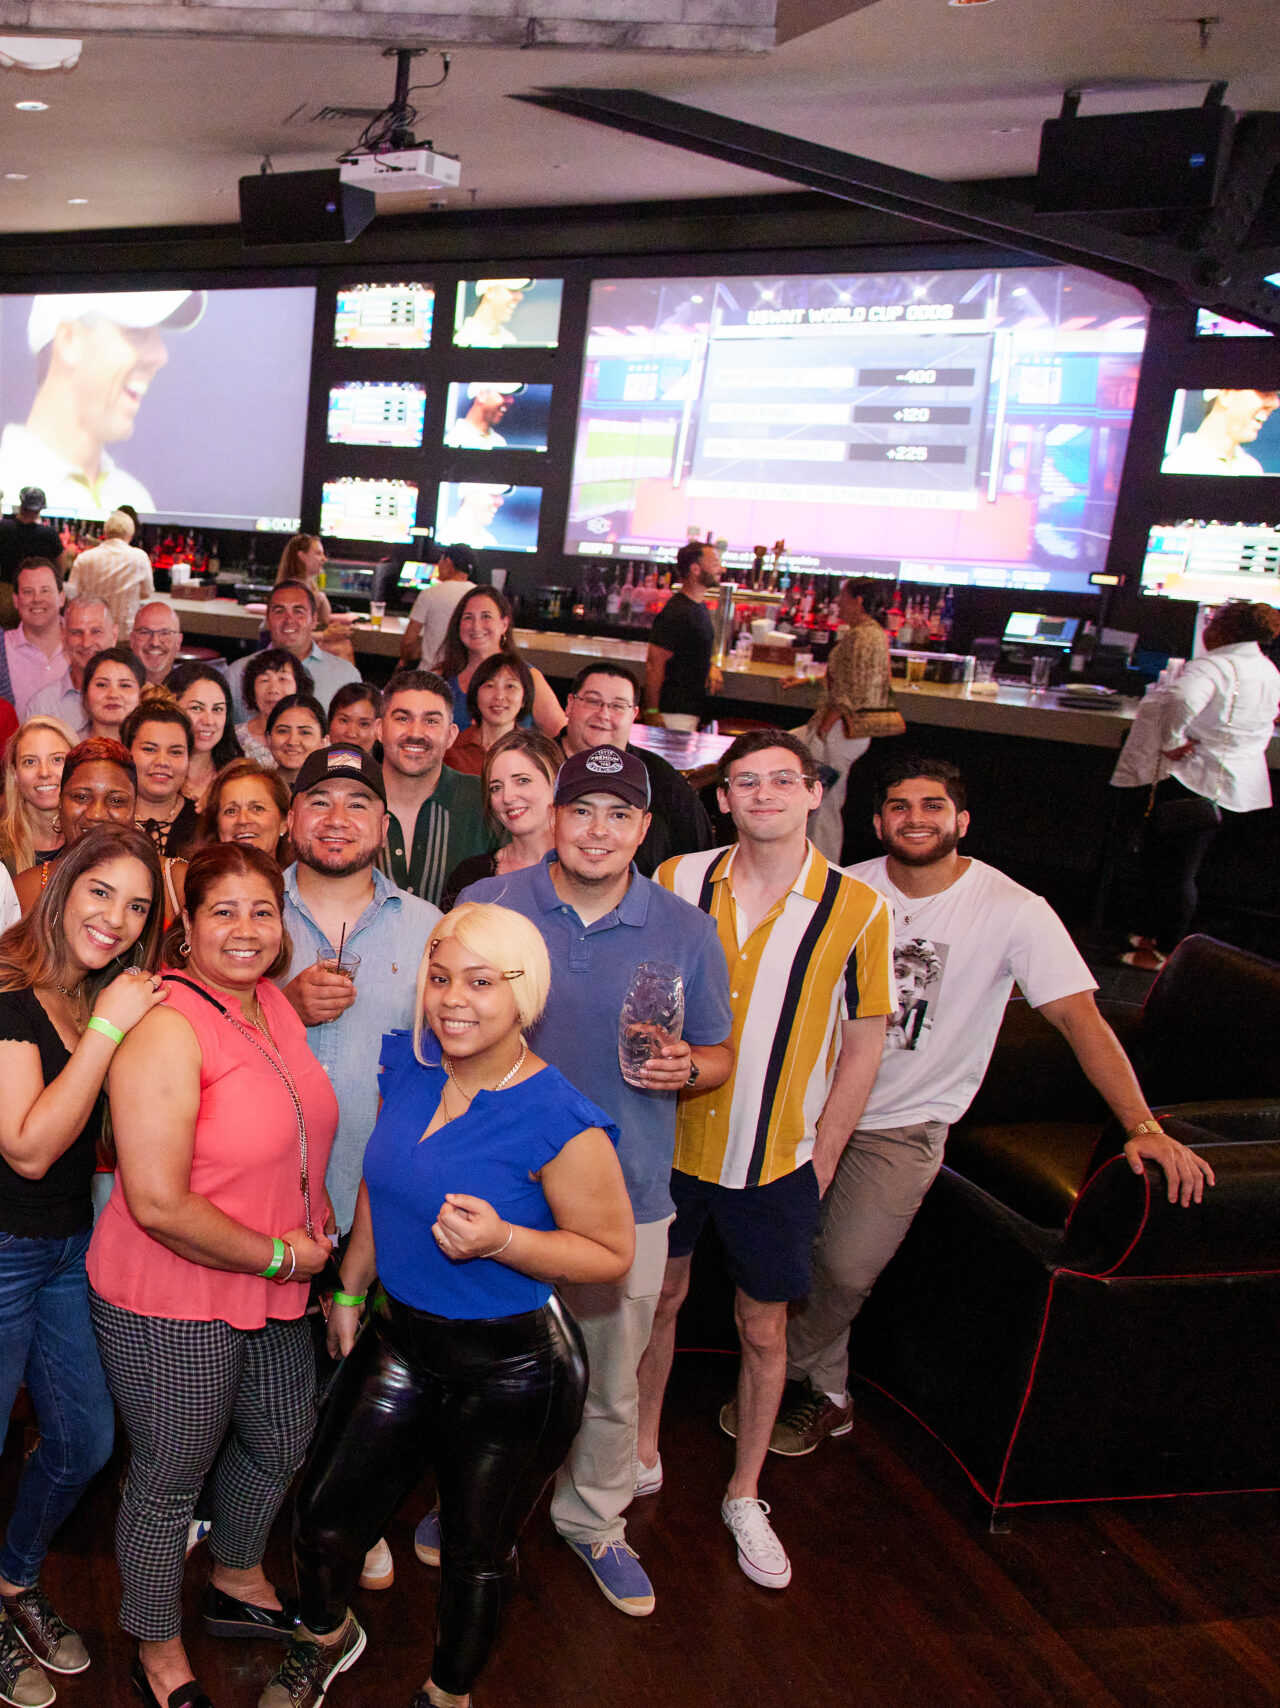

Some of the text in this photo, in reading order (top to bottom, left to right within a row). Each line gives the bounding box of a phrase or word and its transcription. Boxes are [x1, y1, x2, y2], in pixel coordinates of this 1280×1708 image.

[809, 306, 866, 323] WORLD
[868, 305, 904, 322] CUP
[906, 304, 954, 321] ODDS
[896, 369, 936, 384] -400
[759, 407, 796, 419] FINAL
[886, 446, 928, 461] +225
[904, 492, 944, 506] TITLE
[590, 755, 620, 763] PREMIUM
